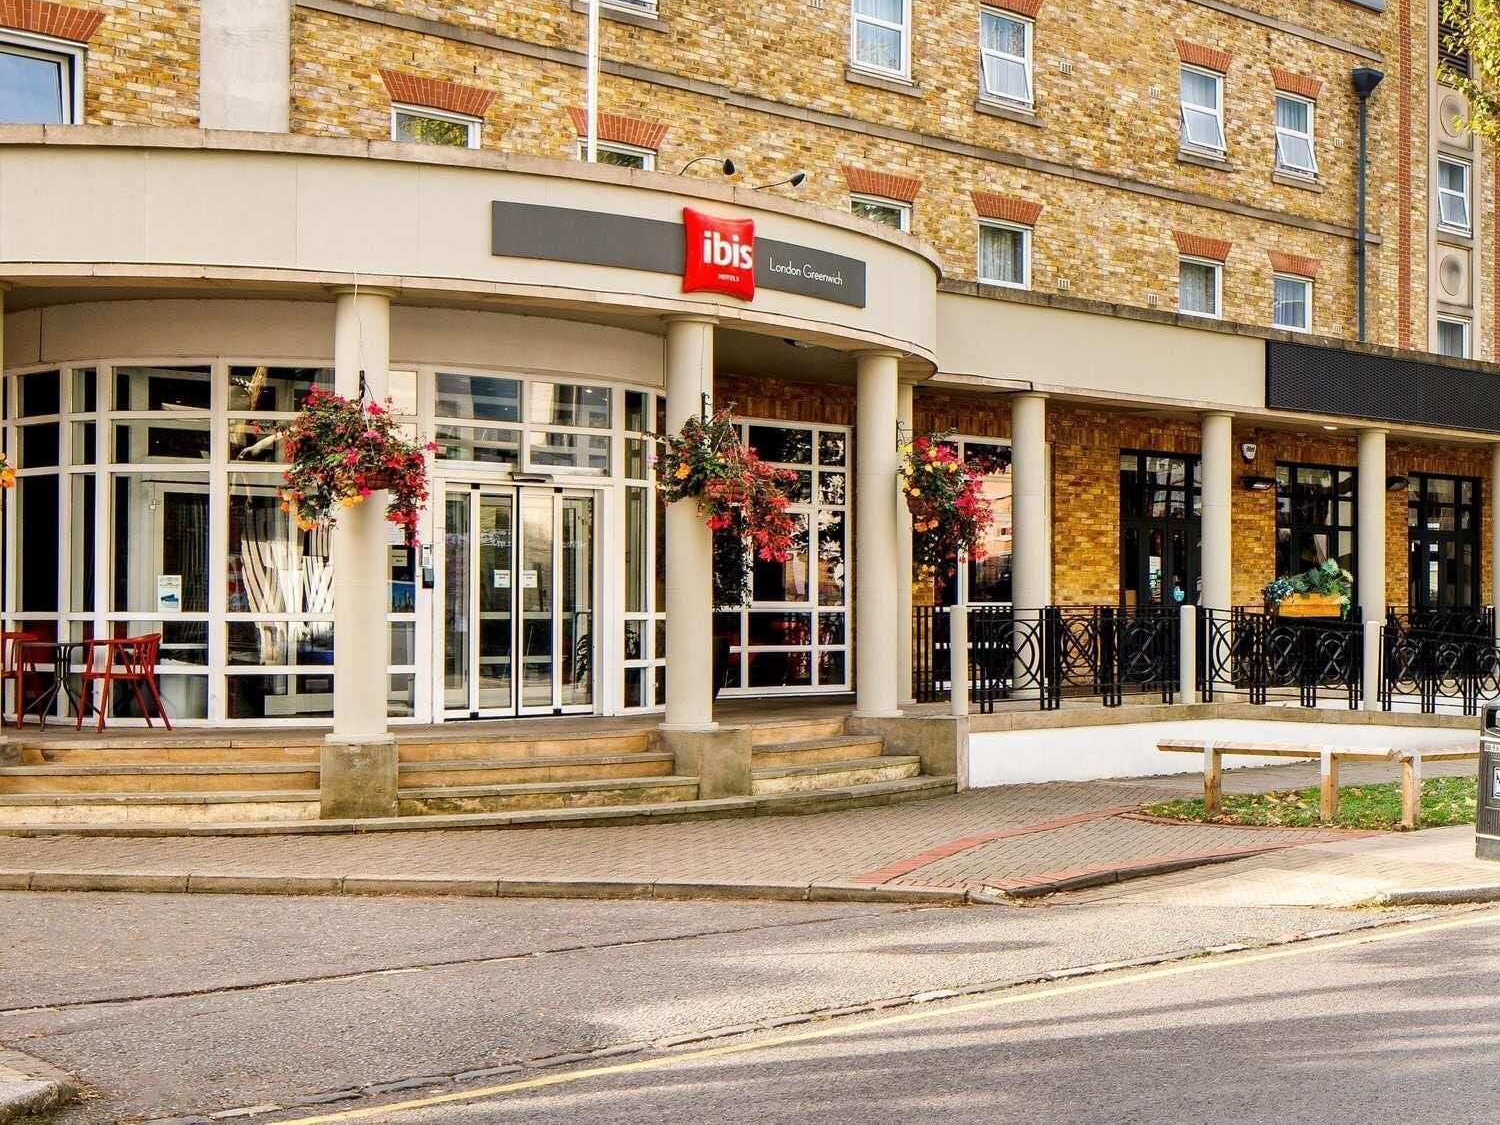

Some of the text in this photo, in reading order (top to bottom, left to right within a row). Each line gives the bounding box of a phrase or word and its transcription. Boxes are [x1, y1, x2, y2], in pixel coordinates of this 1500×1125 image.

[703, 230, 753, 270] ibis
[718, 274, 740, 283] HOTELS
[769, 256, 843, 286] London Greenwich
